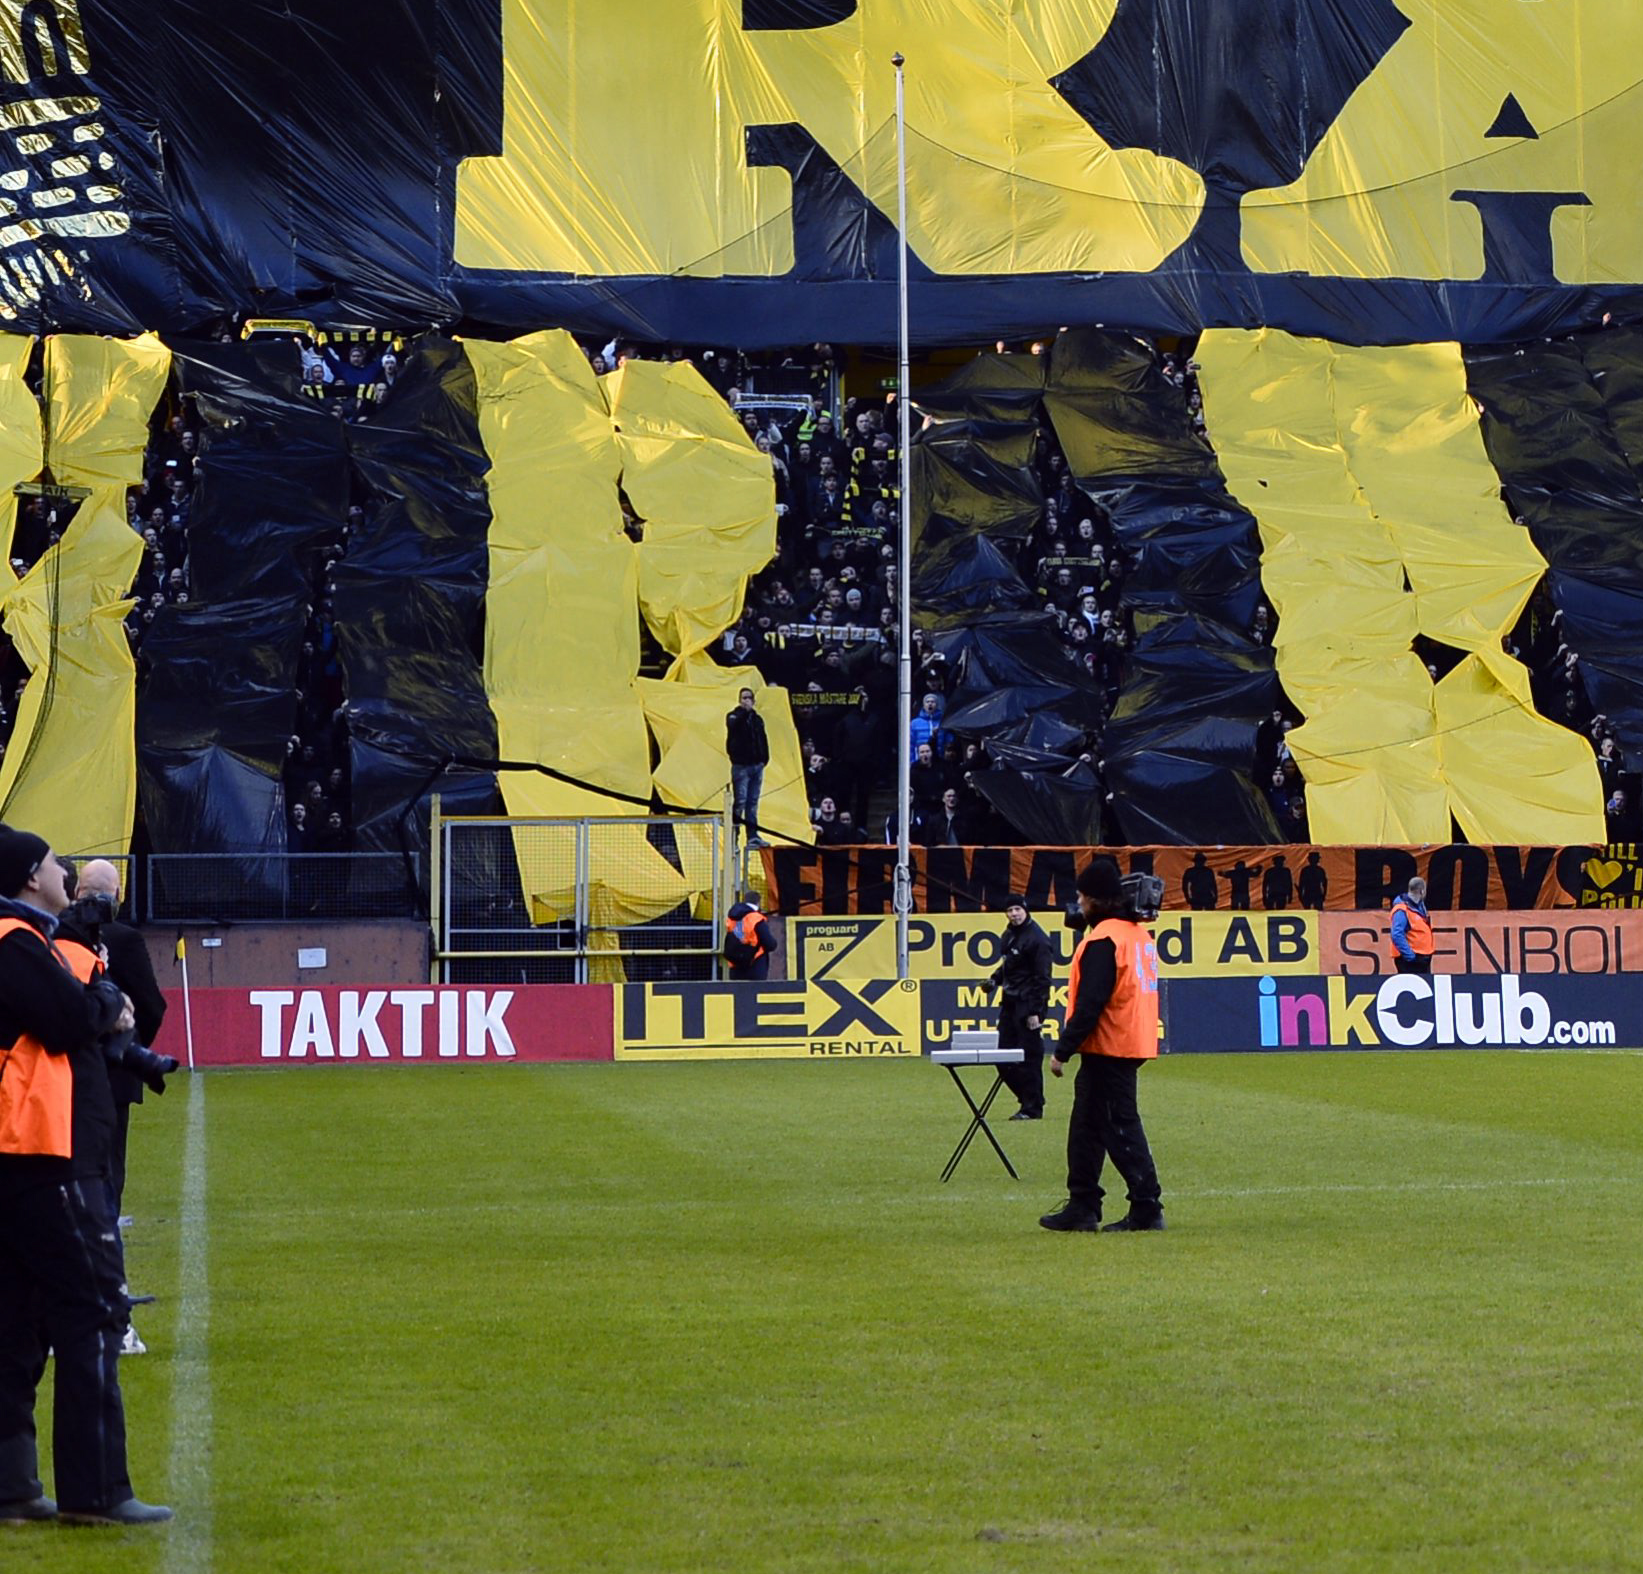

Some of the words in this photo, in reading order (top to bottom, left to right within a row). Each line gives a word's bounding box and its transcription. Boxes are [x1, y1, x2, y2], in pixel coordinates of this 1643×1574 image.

[806, 923, 859, 937] proguard
[818, 942, 835, 953] AB
[1217, 916, 1310, 964] AB
[249, 990, 516, 1058] TAKTIK
[622, 979, 904, 1039] ITEX
[1258, 974, 1616, 1047] inkClub.com
[809, 1041, 912, 1056] RENTAL
